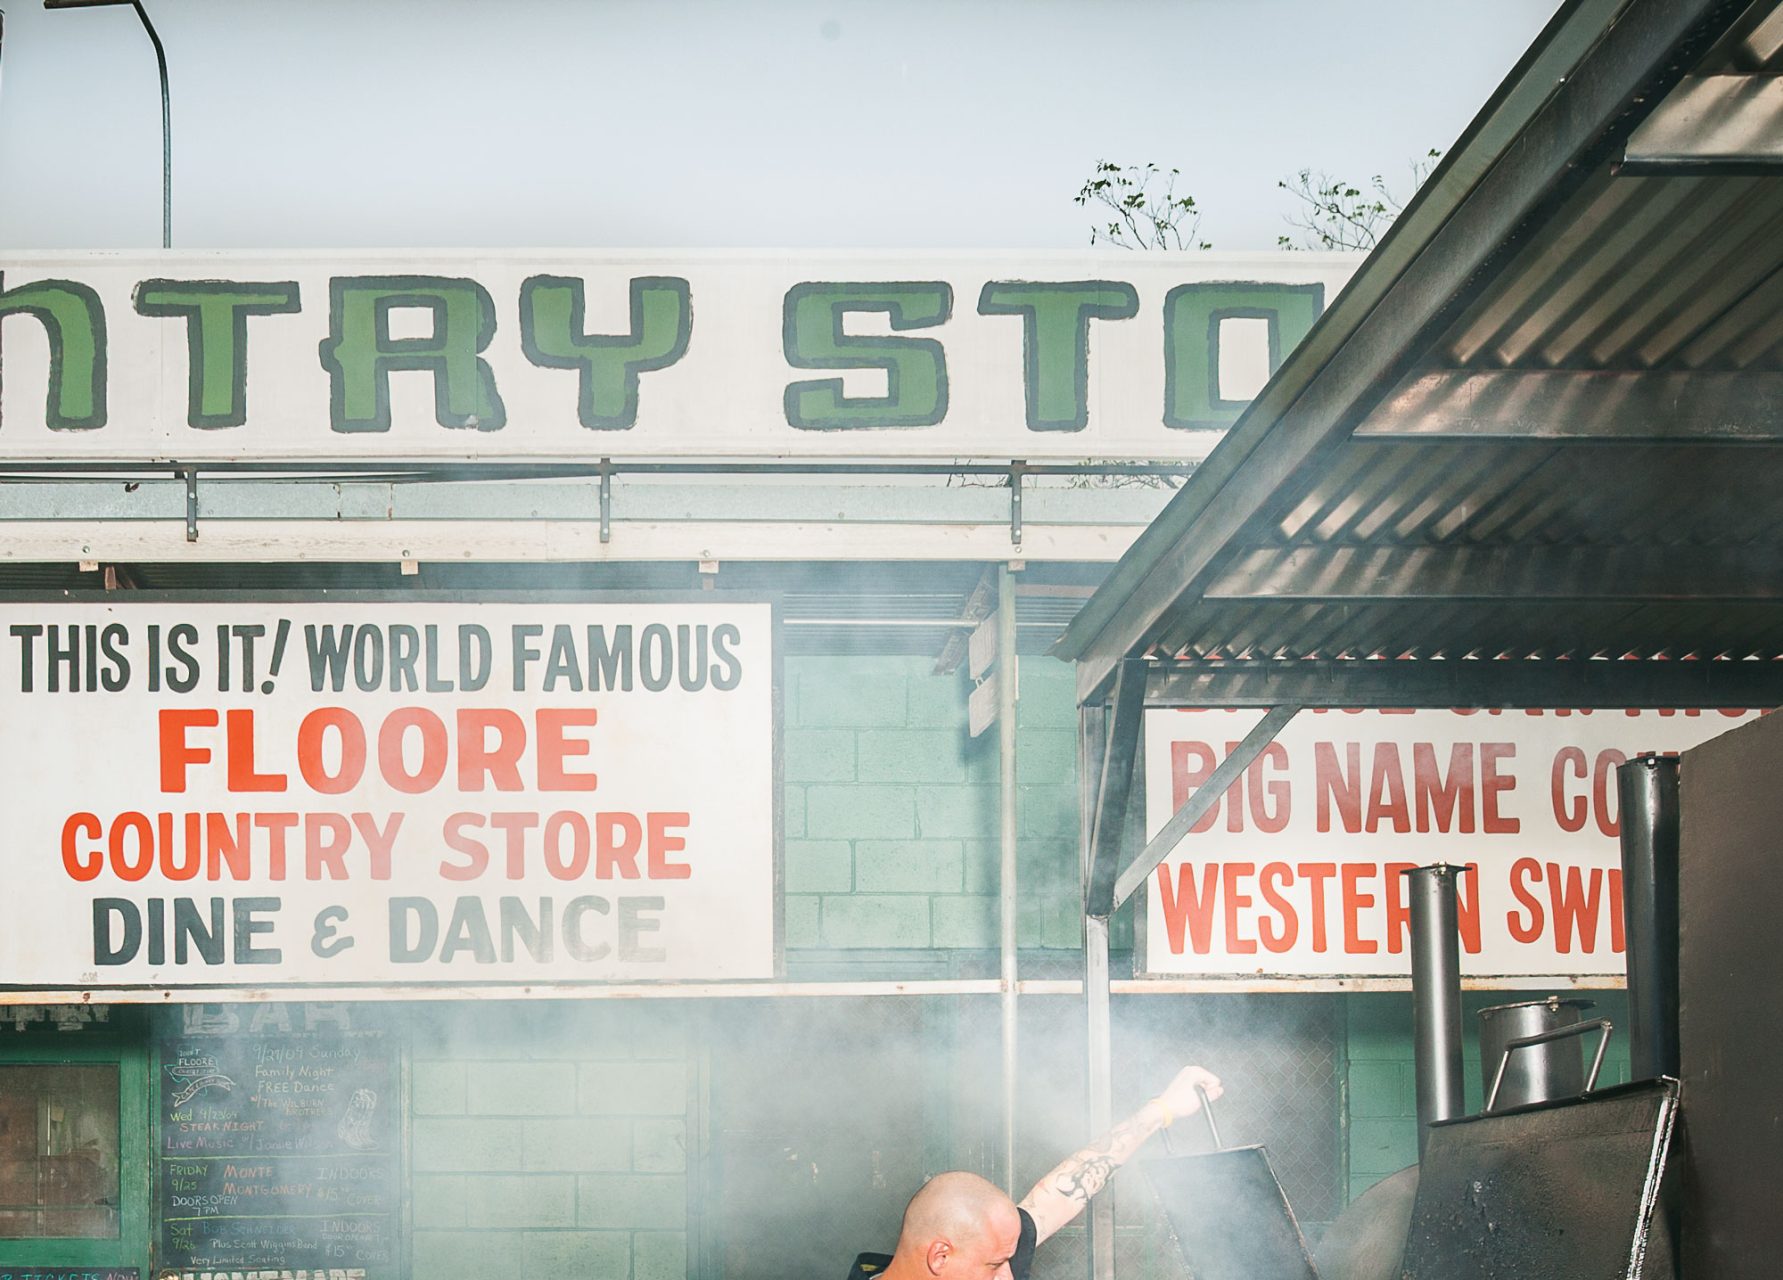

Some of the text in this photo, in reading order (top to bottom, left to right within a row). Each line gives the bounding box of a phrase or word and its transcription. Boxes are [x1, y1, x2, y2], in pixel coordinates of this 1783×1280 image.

[9, 618, 742, 695] THIS IS IT! WORLD FAMOUS
[158, 706, 598, 795] FLOORE
[1170, 741, 1291, 834] BIG
[1315, 742, 1520, 834] NAME
[60, 810, 692, 883] COUNTRY STORE
[92, 895, 667, 967] DINE & DANCE
[309, 1044, 360, 1064] Sunday
[255, 1065, 335, 1080] Family Night
[257, 1080, 289, 1094] FREE
[170, 1109, 193, 1122] Wed
[180, 1121, 264, 1133] STEAK NIGHT
[170, 1164, 209, 1177] FRIDAY
[171, 1179, 197, 1192] 9/25
[172, 1194, 239, 1207] DOORS OPEN
[170, 1223, 193, 1237] Sat
[190, 1255, 210, 1267] Very
